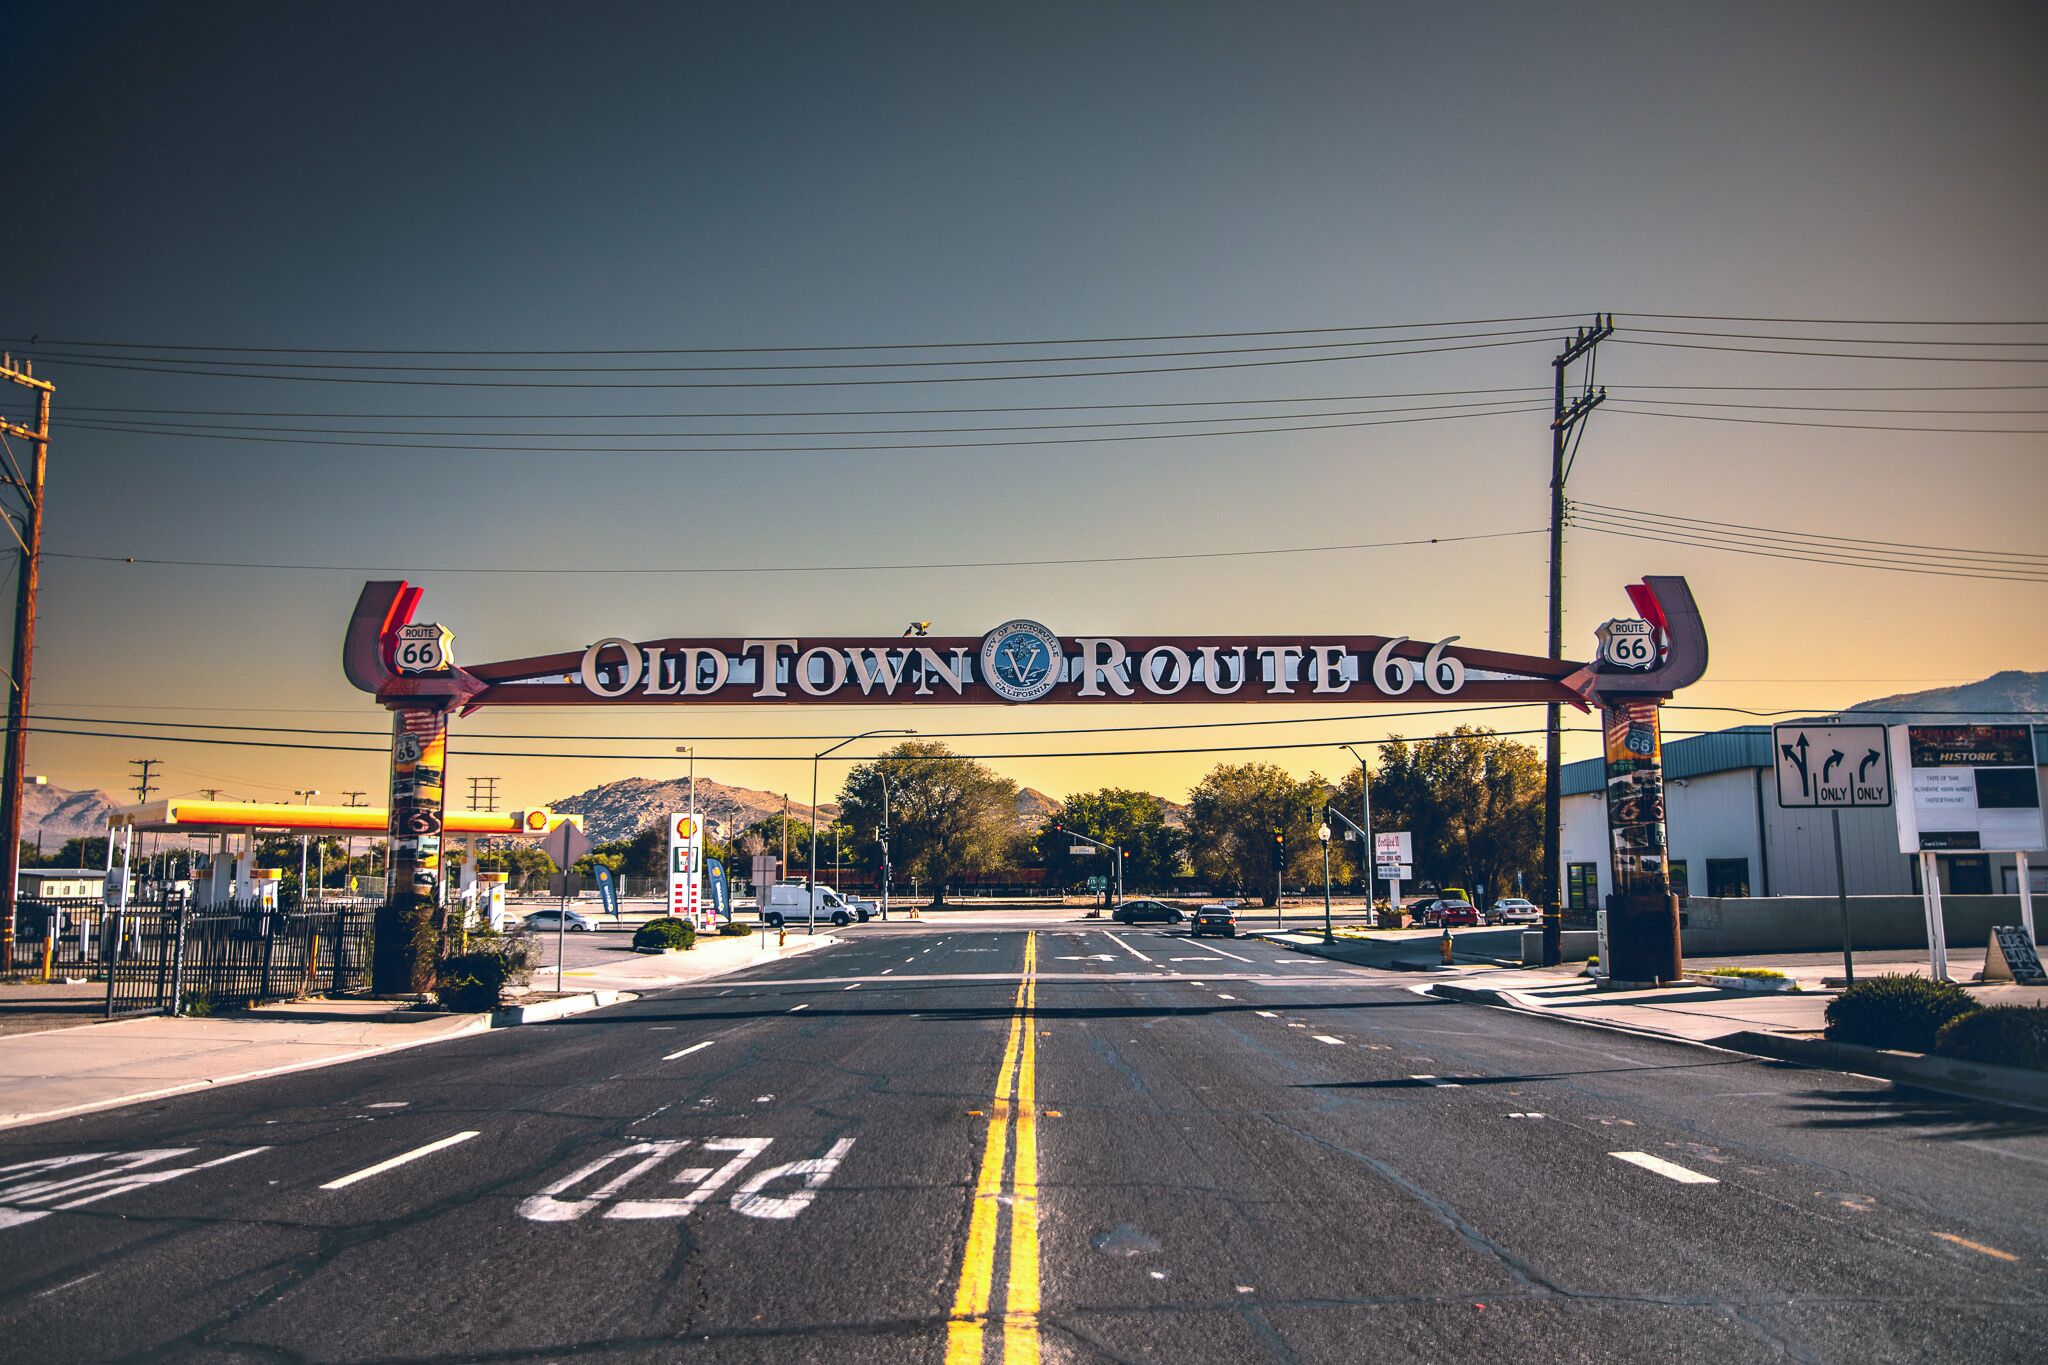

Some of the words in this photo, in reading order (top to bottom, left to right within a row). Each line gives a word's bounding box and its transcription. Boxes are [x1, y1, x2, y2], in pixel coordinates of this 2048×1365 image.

[406, 629, 434, 637] ROUTE
[1615, 624, 1644, 633] ROUTE
[986, 637, 997, 657] CITY
[998, 626, 1009, 636] OF
[1012, 624, 1059, 657] VICTORVILLE
[403, 643, 434, 664] 66
[1616, 638, 1646, 660] 66
[581, 637, 730, 697] OLD
[742, 639, 969, 697] TOWN
[1075, 637, 1352, 696] ROUTE
[1372, 635, 1466, 695] 66
[1005, 648, 1041, 682] V
[995, 682, 1050, 697] CALIFORNIA
[398, 741, 416, 759] 66
[1630, 738, 1650, 752] 66
[1940, 752, 1998, 761] HISTORIC
[1821, 787, 1847, 801] ONLY
[1857, 787, 1884, 801] ONLY
